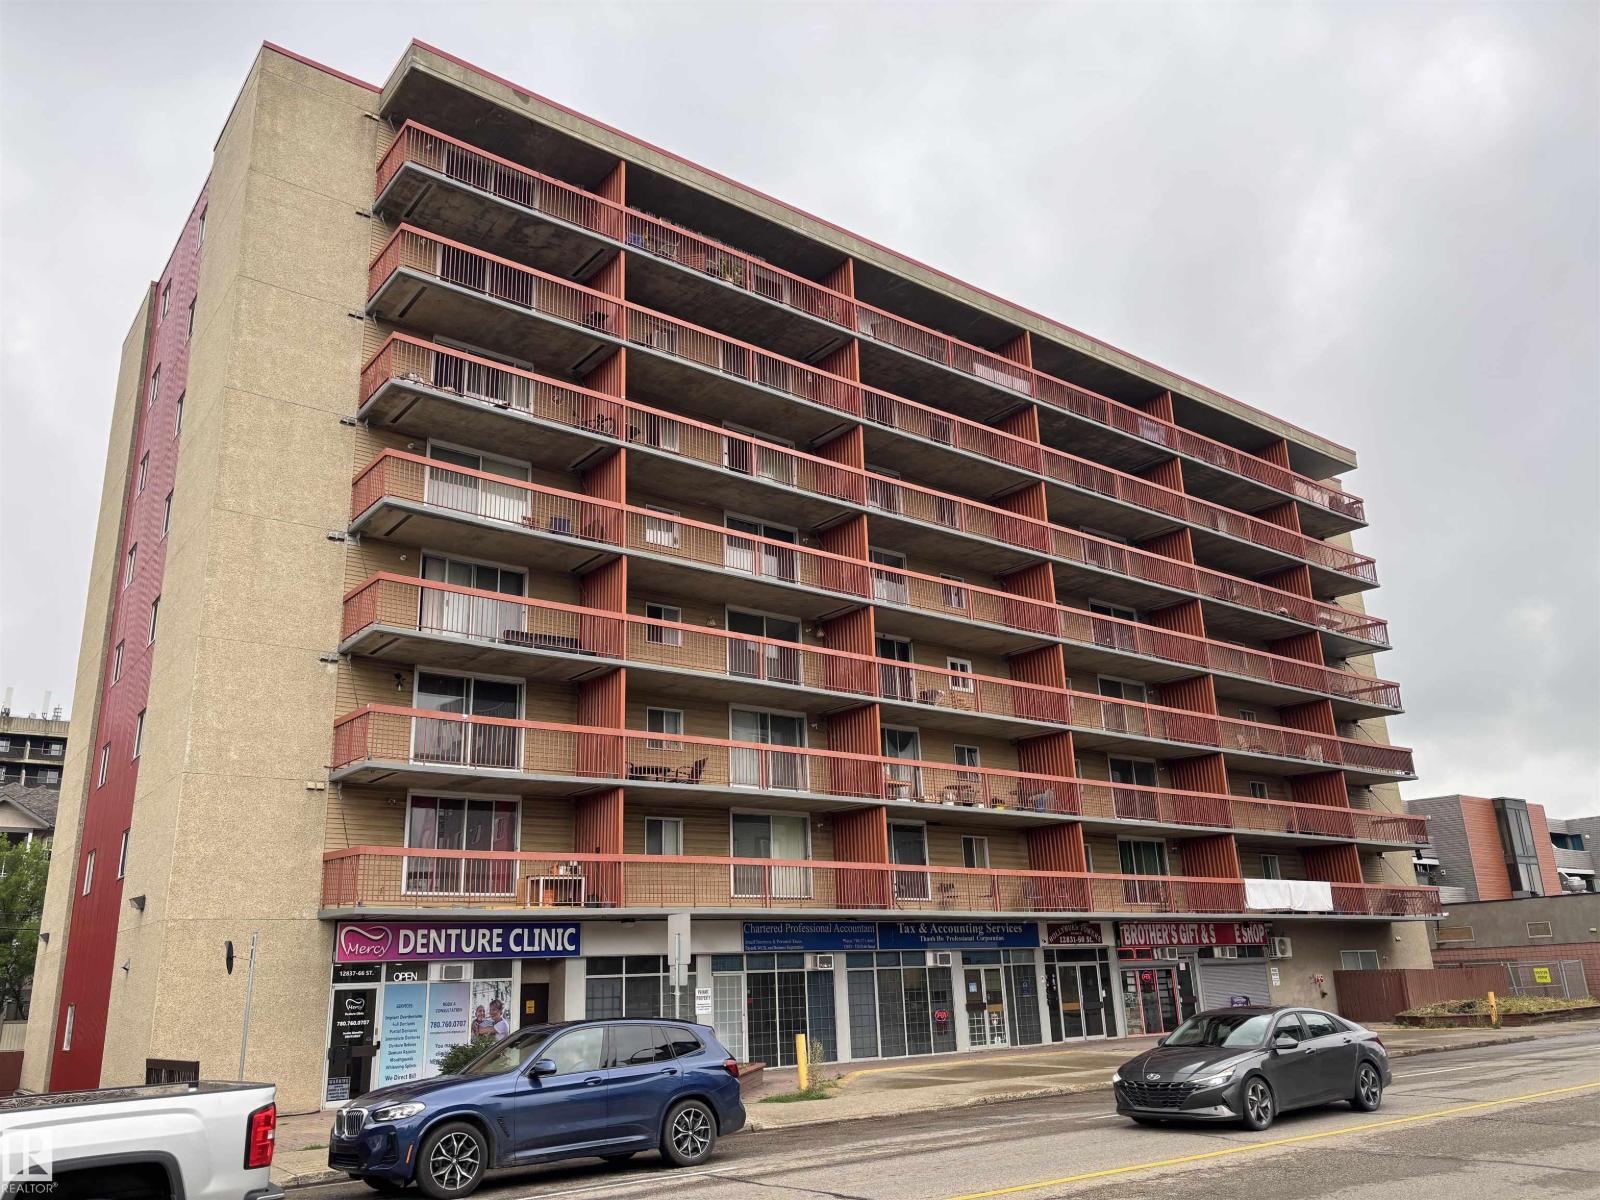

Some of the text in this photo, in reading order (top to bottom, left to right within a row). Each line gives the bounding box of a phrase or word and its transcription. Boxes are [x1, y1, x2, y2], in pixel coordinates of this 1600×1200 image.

[744, 922, 875, 933] Chartered Professional Accountant
[897, 922, 1023, 936] Tax & Accounting Services
[1123, 923, 1178, 945] BROTHER'S
[1180, 923, 1200, 944] GIFT
[1201, 923, 1210, 944] &
[1243, 923, 1265, 943] SHOP
[398, 927, 576, 954] DENTURE CLINIC
[347, 942, 386, 957] Mercy
[393, 972, 418, 982] OPEN
